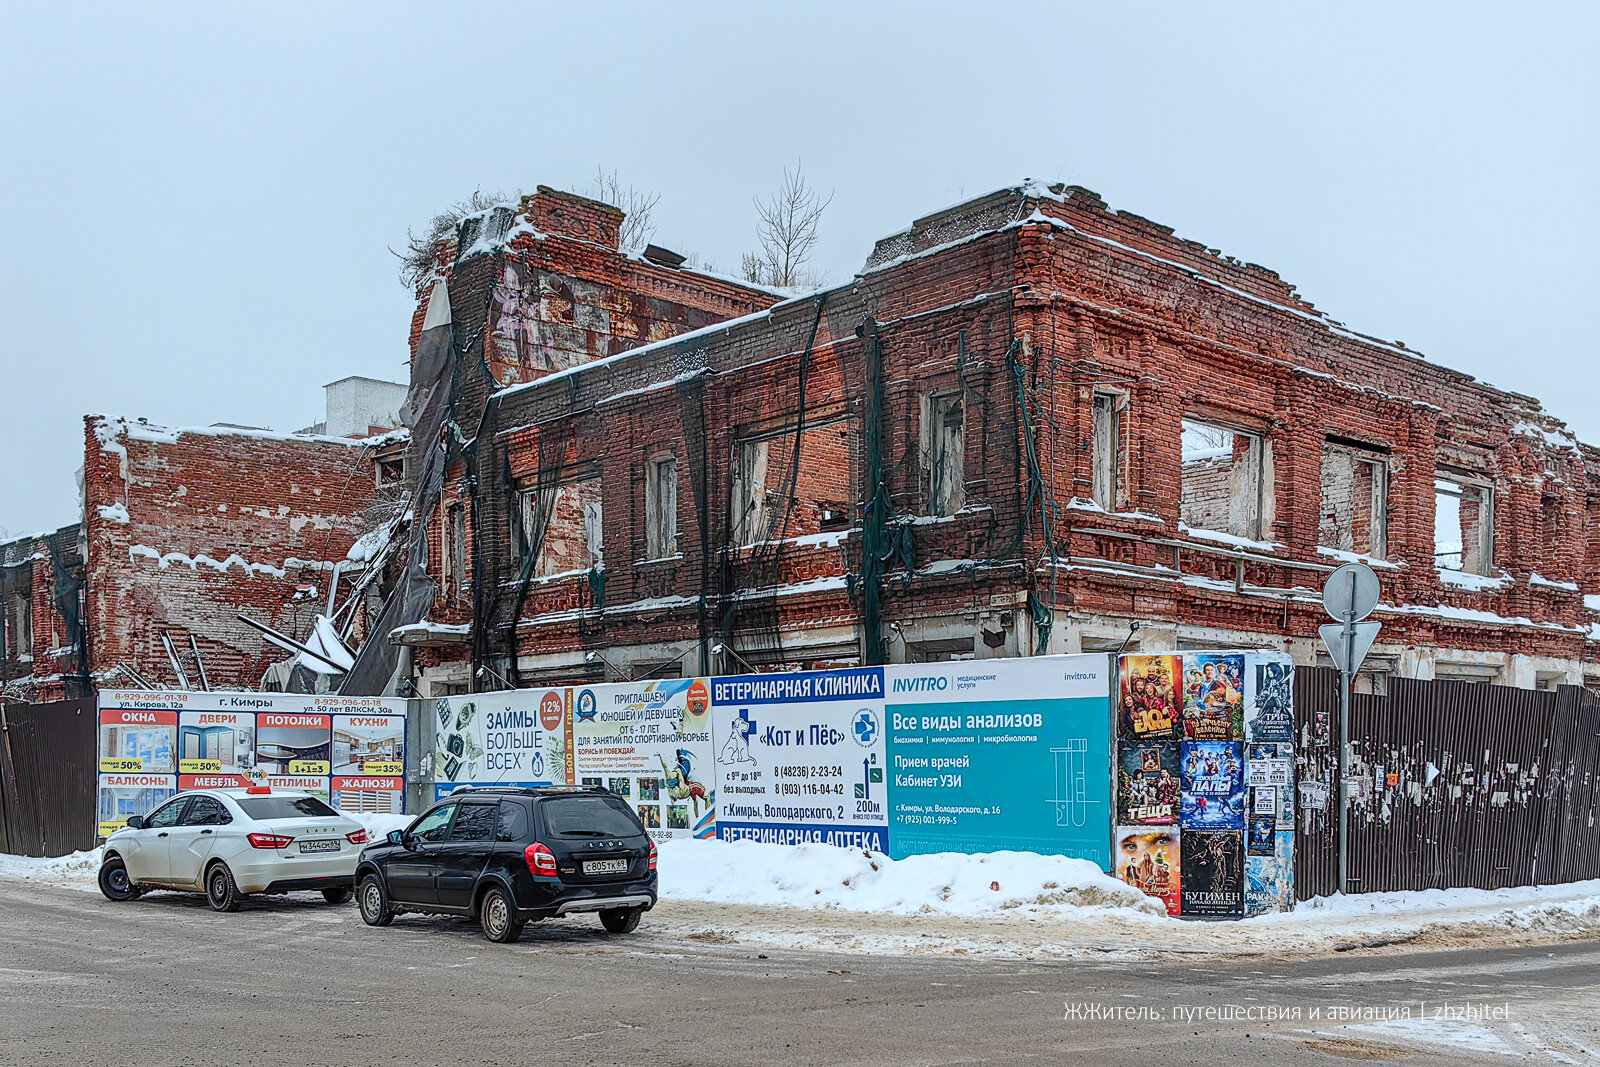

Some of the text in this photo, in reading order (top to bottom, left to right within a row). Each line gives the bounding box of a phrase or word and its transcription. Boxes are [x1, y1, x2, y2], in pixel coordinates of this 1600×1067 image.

[957, 674, 996, 682] медицинские
[1064, 672, 1096, 680] invitro.ru
[715, 674, 880, 700] ВЕТЕРИНАРНАЯ КЛИНИКА
[893, 676, 948, 692] INVITRO
[115, 693, 188, 701] 8-929-096-01-38
[614, 692, 666, 704] ПРИГЛАШАЕМ
[230, 698, 272, 709] Кимры
[542, 700, 560, 712] 12%
[121, 712, 156, 722] ОКНА
[199, 714, 237, 724] ДВЕРИ
[486, 706, 536, 730] ЗАЙМЫ
[600, 708, 683, 722] ЮНОШЕЙ И ДЕВУШЕК
[266, 716, 322, 726] ПОТОЛКИ
[350, 718, 388, 727] КУХНИ
[893, 713, 918, 730] Все
[922, 714, 962, 732] виды
[966, 713, 1043, 729] анализов
[620, 725, 660, 734] ОТ 6 17 ЛЕТ
[760, 726, 791, 746] «Кот
[796, 730, 804, 746] и
[810, 724, 845, 746] Пёс»
[486, 731, 542, 750] БОЛЬШЕ
[578, 732, 709, 746] ДЛЯ ЗАНЯТИЙ ПО СПОРТИВНОЙ БОРЬБЕ
[894, 734, 1037, 745] биохимия иммунология микробиология
[121, 761, 142, 770] 50%
[200, 762, 220, 771] 50%
[895, 754, 970, 771] Прием врачей
[294, 765, 324, 773] 1+1=3
[383, 764, 402, 773] 35%
[774, 766, 842, 780] 8 (48236) 2-23-24
[107, 776, 169, 786] БАЛКОНЫ
[194, 777, 239, 787] МЕБЕЛЬ
[267, 778, 322, 788] ТЕПЛИЦЫ
[341, 778, 394, 788] ЖАЛЮЗИ
[741, 773, 748, 782] до
[895, 774, 962, 788] Кабинет УЗИ
[724, 784, 765, 796] без выходных
[775, 784, 844, 797] 8 (903) 116-04-42
[1191, 781, 1232, 791] ПАПЫ
[723, 803, 844, 821] г.Кимры, Володарского, 2
[856, 800, 880, 813] 200м
[901, 804, 924, 813] Кимры,
[934, 804, 983, 815] Володарского,
[984, 807, 990, 815] д.
[992, 806, 1001, 814] 16
[1128, 804, 1172, 819] ТЁЩА
[905, 815, 922, 824] (925)
[923, 816, 957, 825] 001-999-5
[722, 827, 822, 845] ВЕТЕРИНАРНАЯ
[826, 830, 882, 852] АПТЕКА
[1185, 892, 1240, 901] БУГИМЕН
